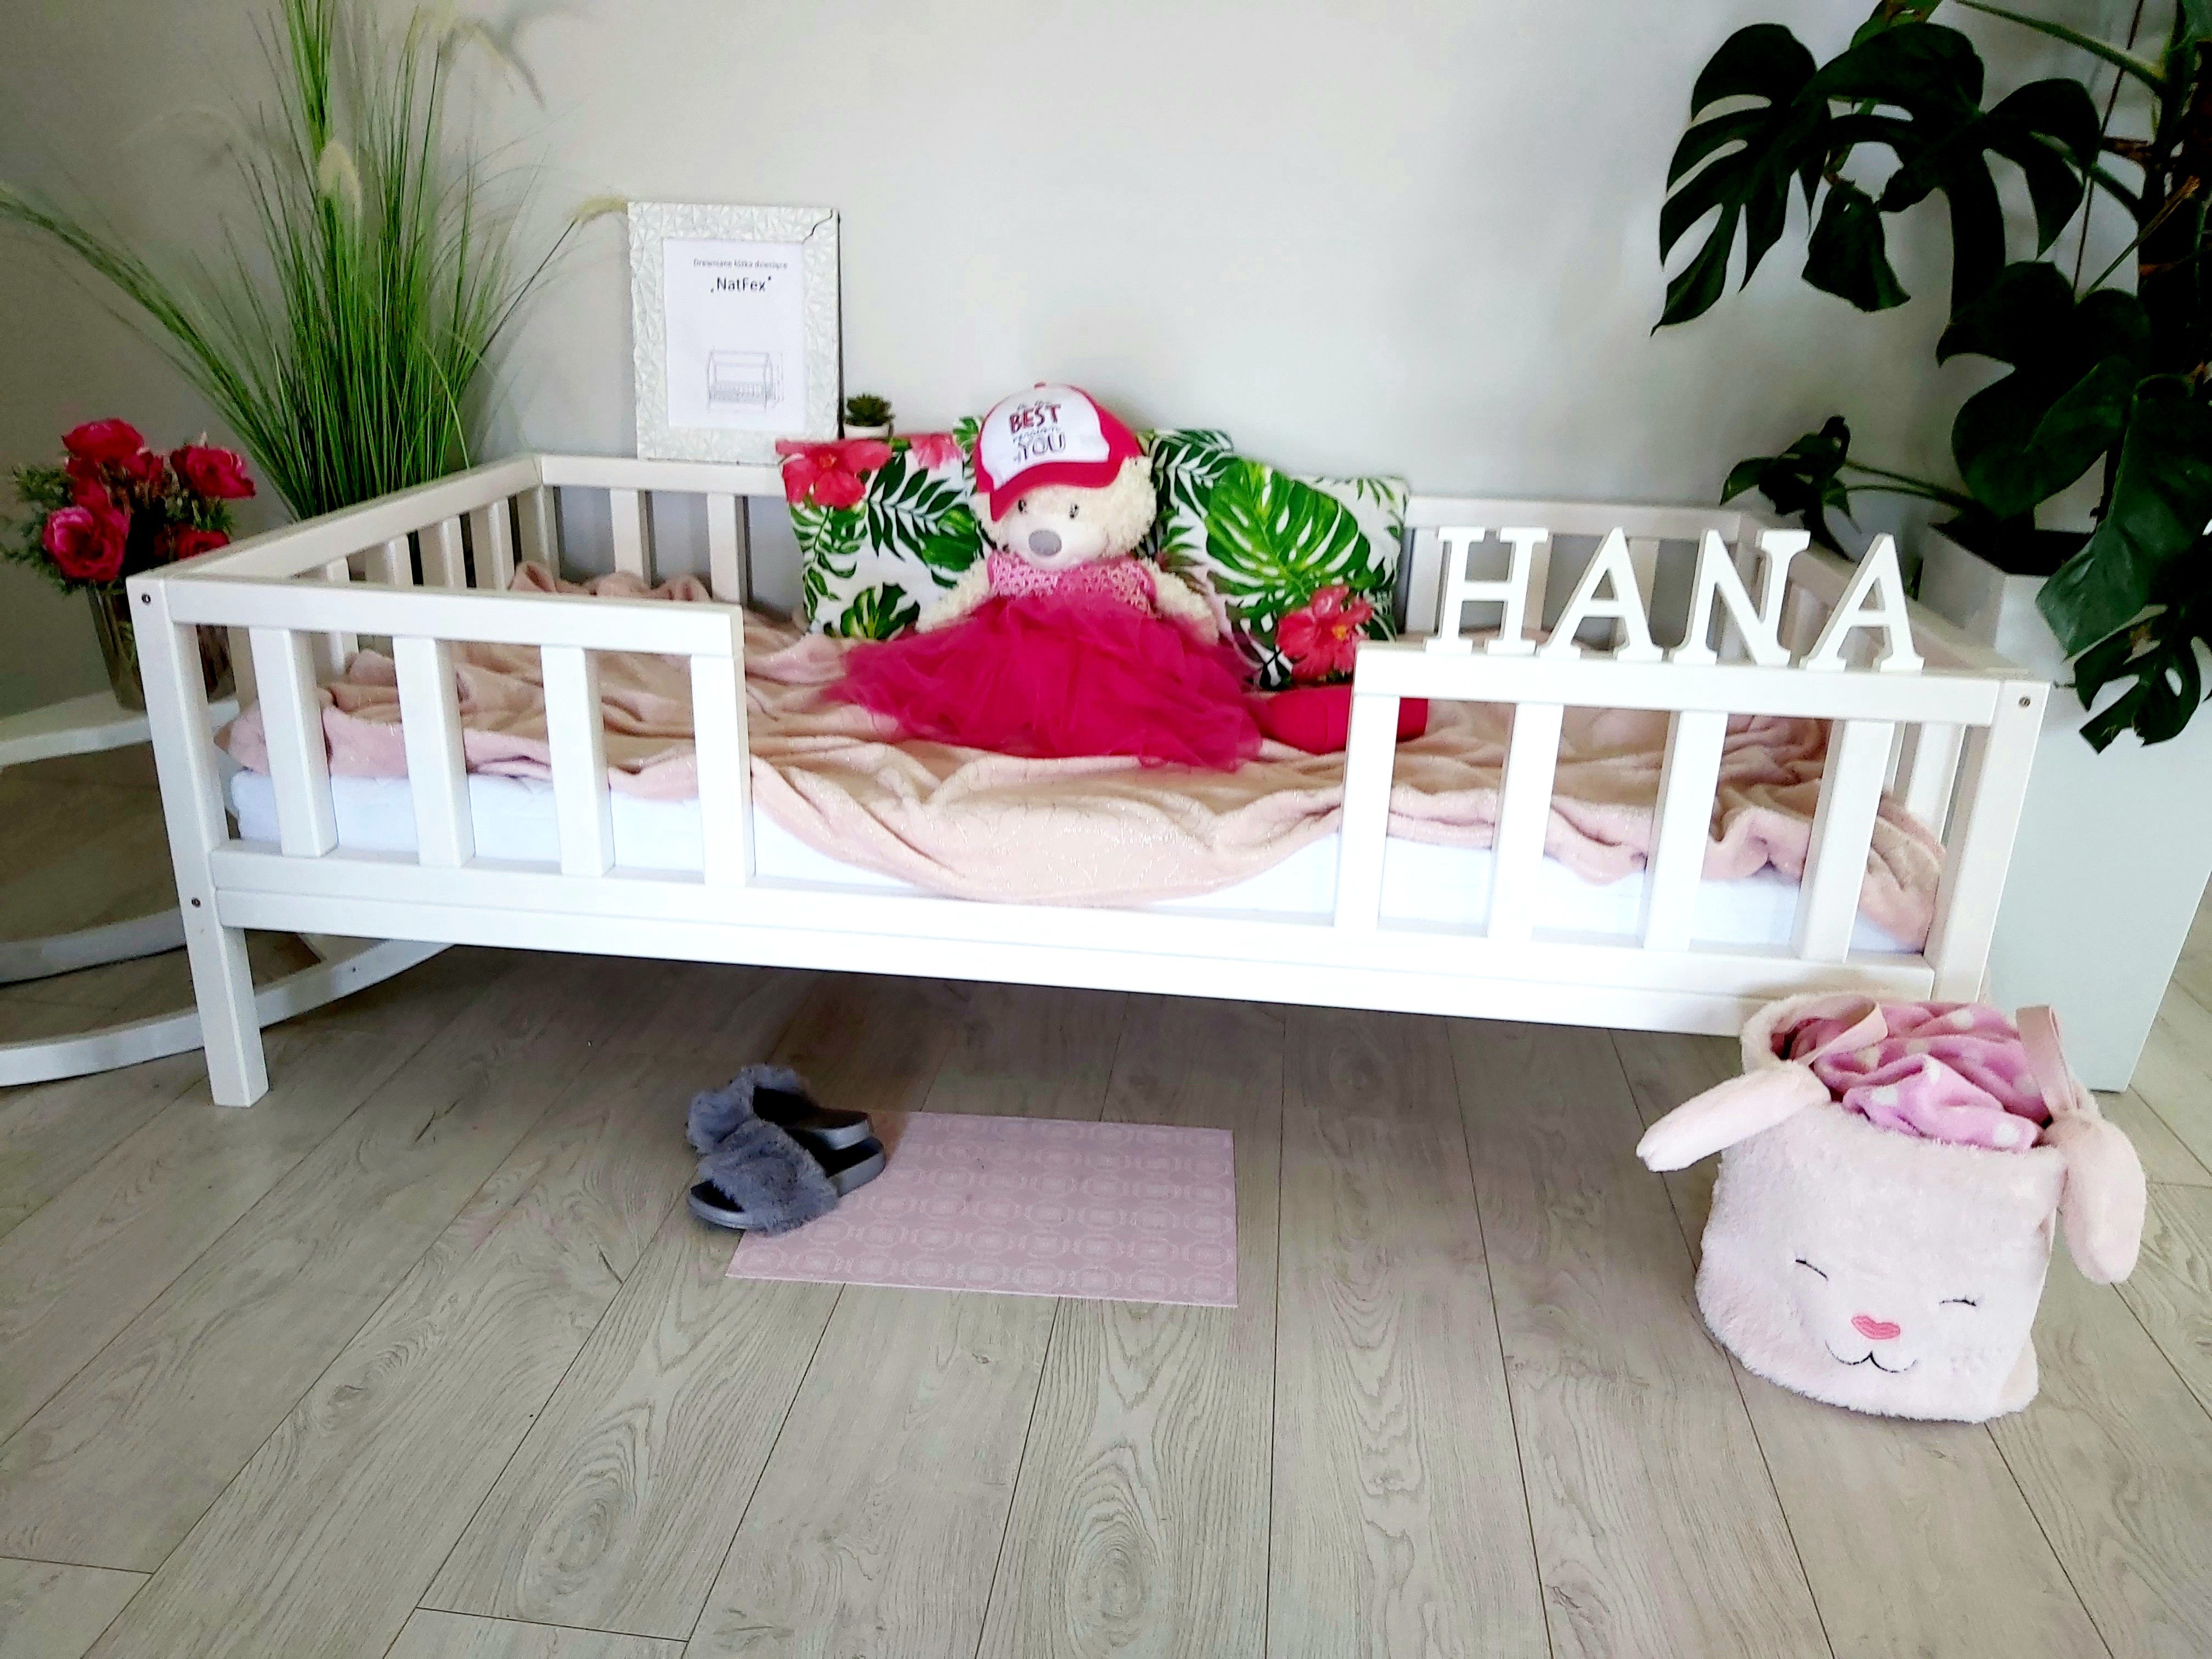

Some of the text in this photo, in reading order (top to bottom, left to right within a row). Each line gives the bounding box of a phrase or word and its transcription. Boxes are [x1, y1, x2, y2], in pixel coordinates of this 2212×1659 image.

[1009, 404, 1062, 434] BEST
[1018, 432, 1066, 460] YOU
[1425, 527, 1925, 672] HANA
